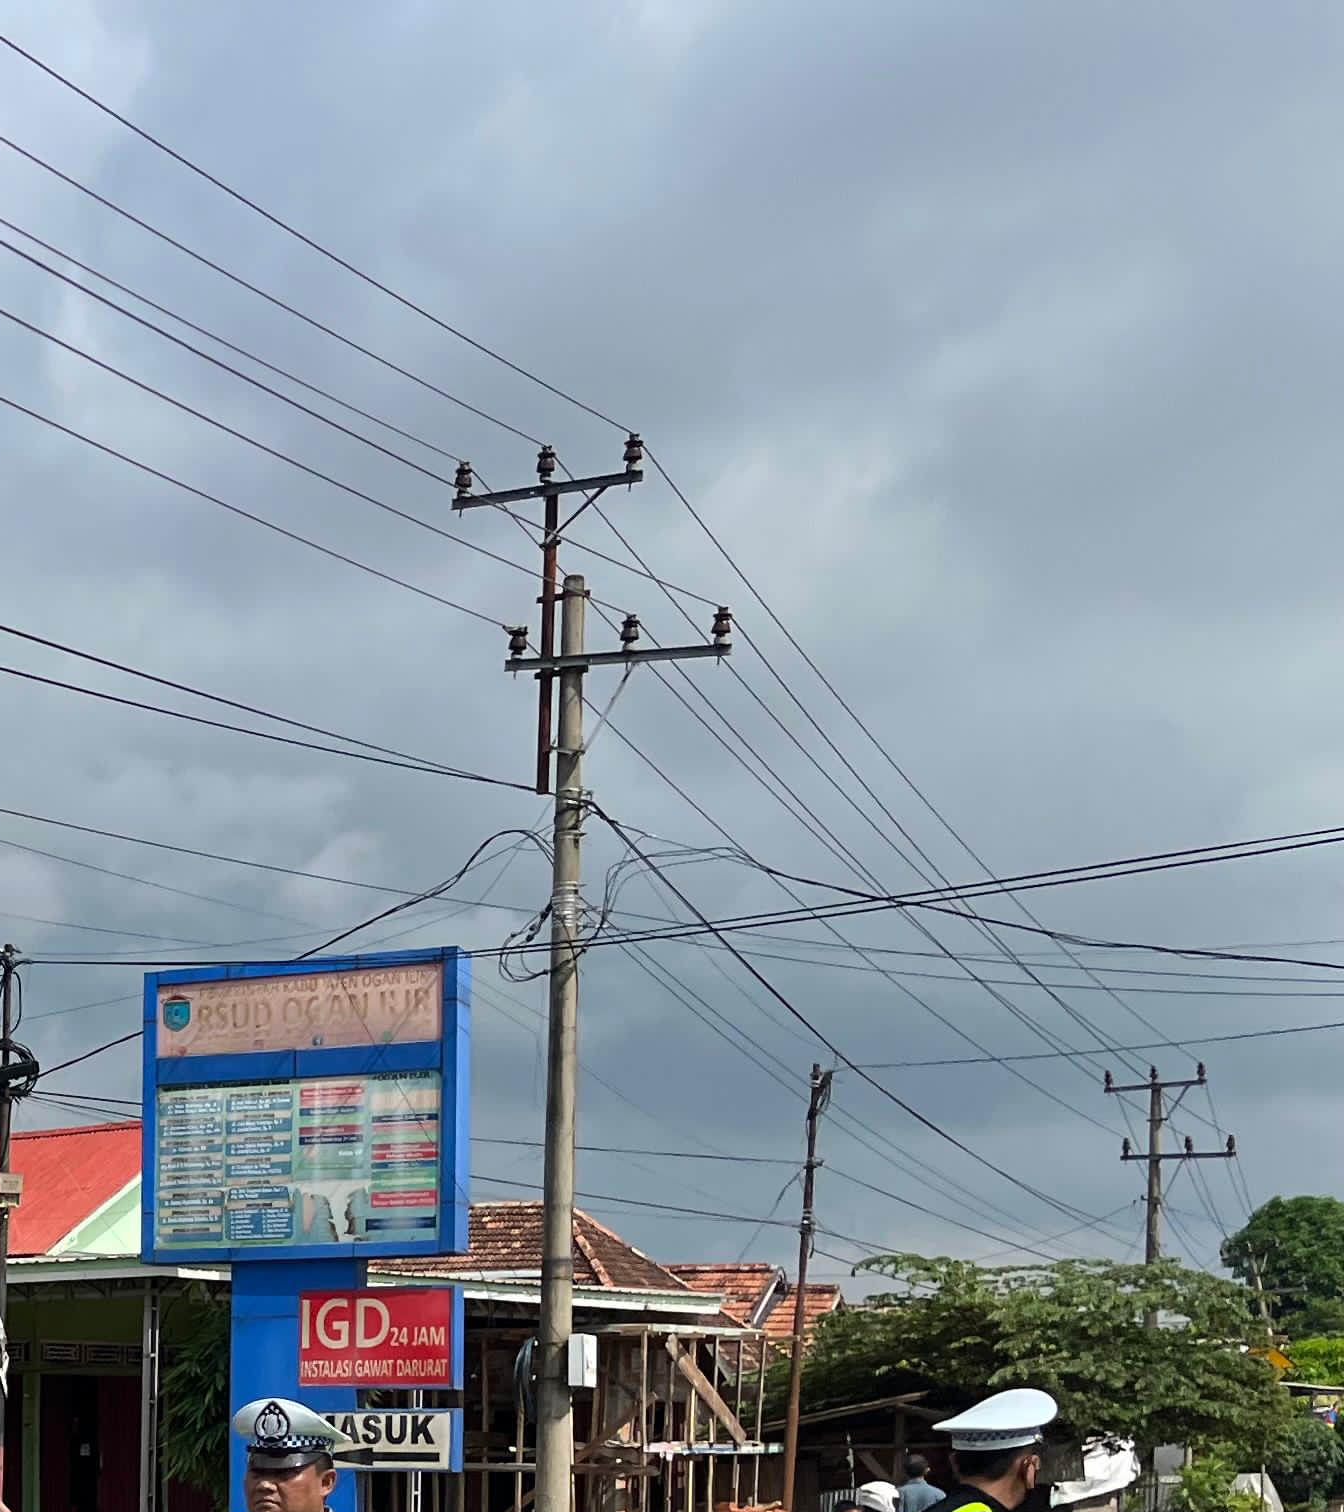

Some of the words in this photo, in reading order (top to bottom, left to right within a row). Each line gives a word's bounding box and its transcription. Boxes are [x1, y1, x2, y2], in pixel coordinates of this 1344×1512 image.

[301, 1298, 390, 1350] IGD
[390, 1327, 409, 1347] 24
[412, 1326, 445, 1346] JAM
[300, 1359, 352, 1378] INSTALASI
[355, 1359, 394, 1377] GAWAT
[397, 1358, 447, 1377] DARURAT
[323, 1415, 435, 1445] ASUK
